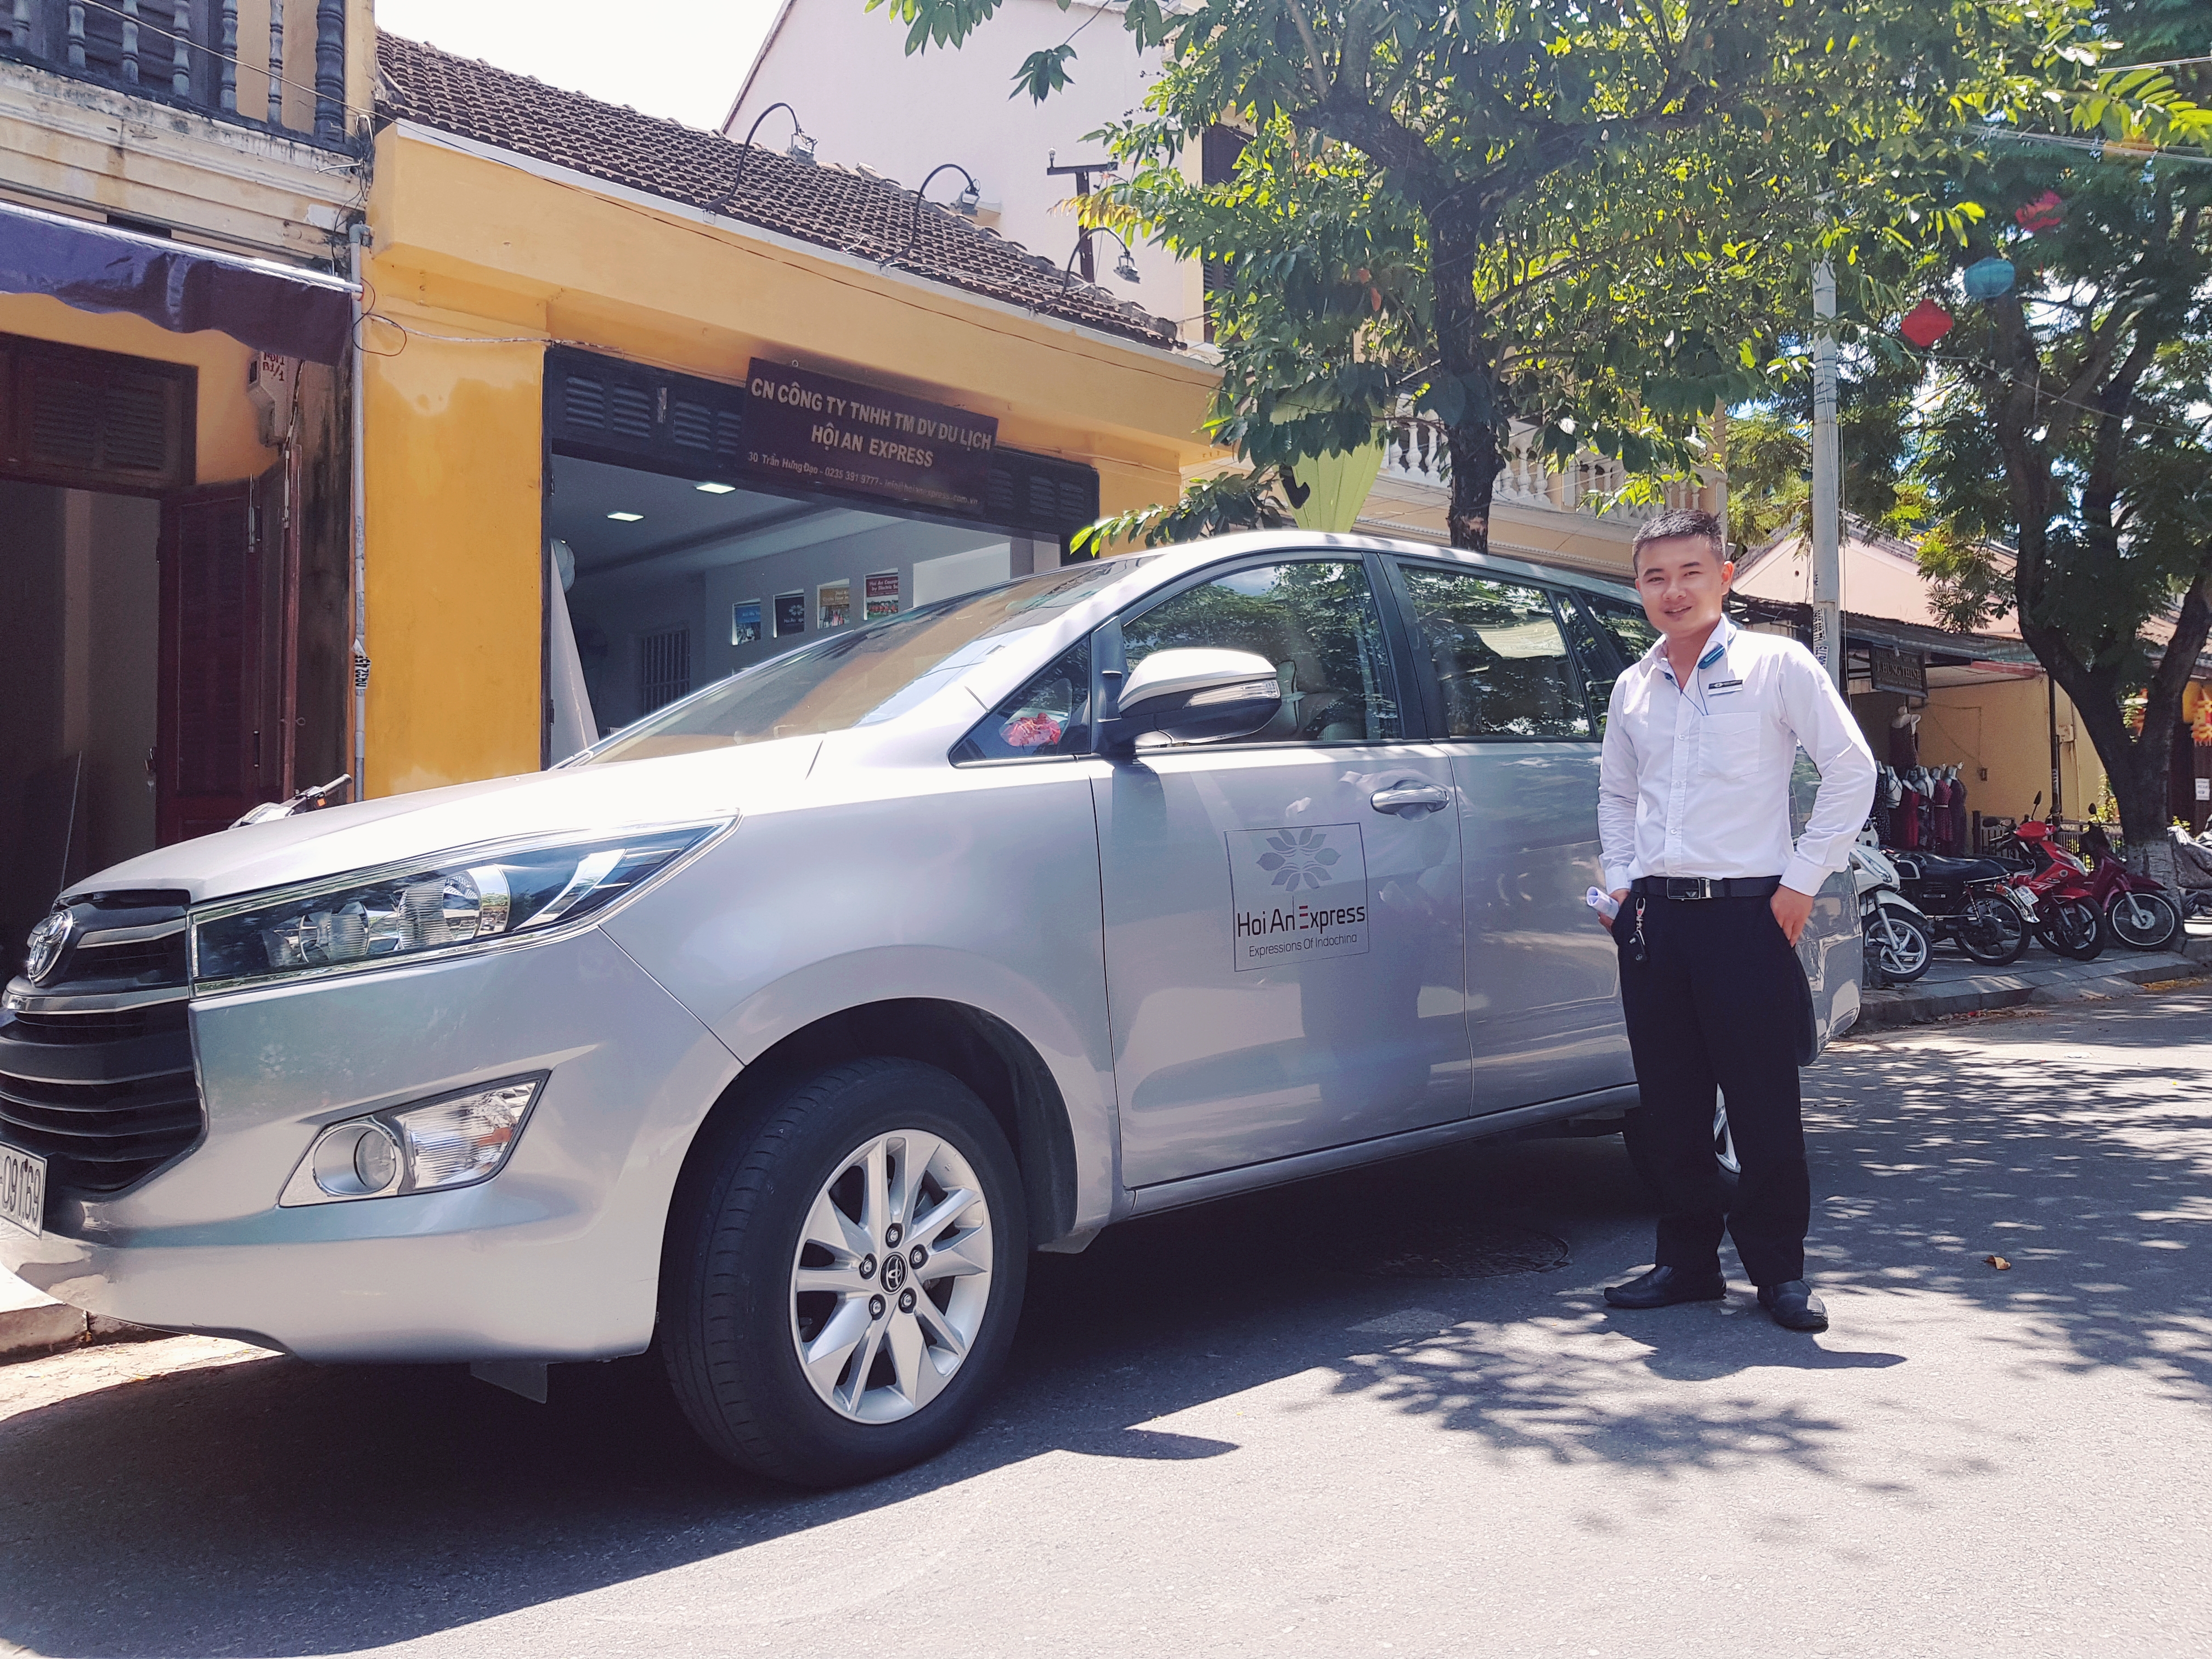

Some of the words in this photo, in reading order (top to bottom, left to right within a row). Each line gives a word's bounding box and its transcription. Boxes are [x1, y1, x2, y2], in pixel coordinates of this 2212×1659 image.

[751, 378, 775, 400] CN
[777, 381, 823, 411] CÔNG
[826, 396, 847, 416] TY
[850, 402, 891, 427] TNHH
[894, 413, 915, 433] TM
[917, 418, 938, 437] DV
[938, 423, 958, 442] DU
[960, 428, 992, 452] LỊCH
[811, 422, 840, 451] HỘI
[840, 432, 864, 452] AN
[868, 438, 934, 467] EXPRESS
[748, 452, 758, 462] 30
[762, 453, 780, 466] Trần
[825, 467, 844, 479] 0235
[845, 471, 859, 482] 391
[1237, 911, 1266, 938] Hoi
[1269, 896, 1295, 933] An
[1299, 905, 1365, 934] Express
[1249, 941, 1302, 958] Expressions
[1304, 937, 1313, 949] Of
[1315, 934, 1357, 947] Indochina
